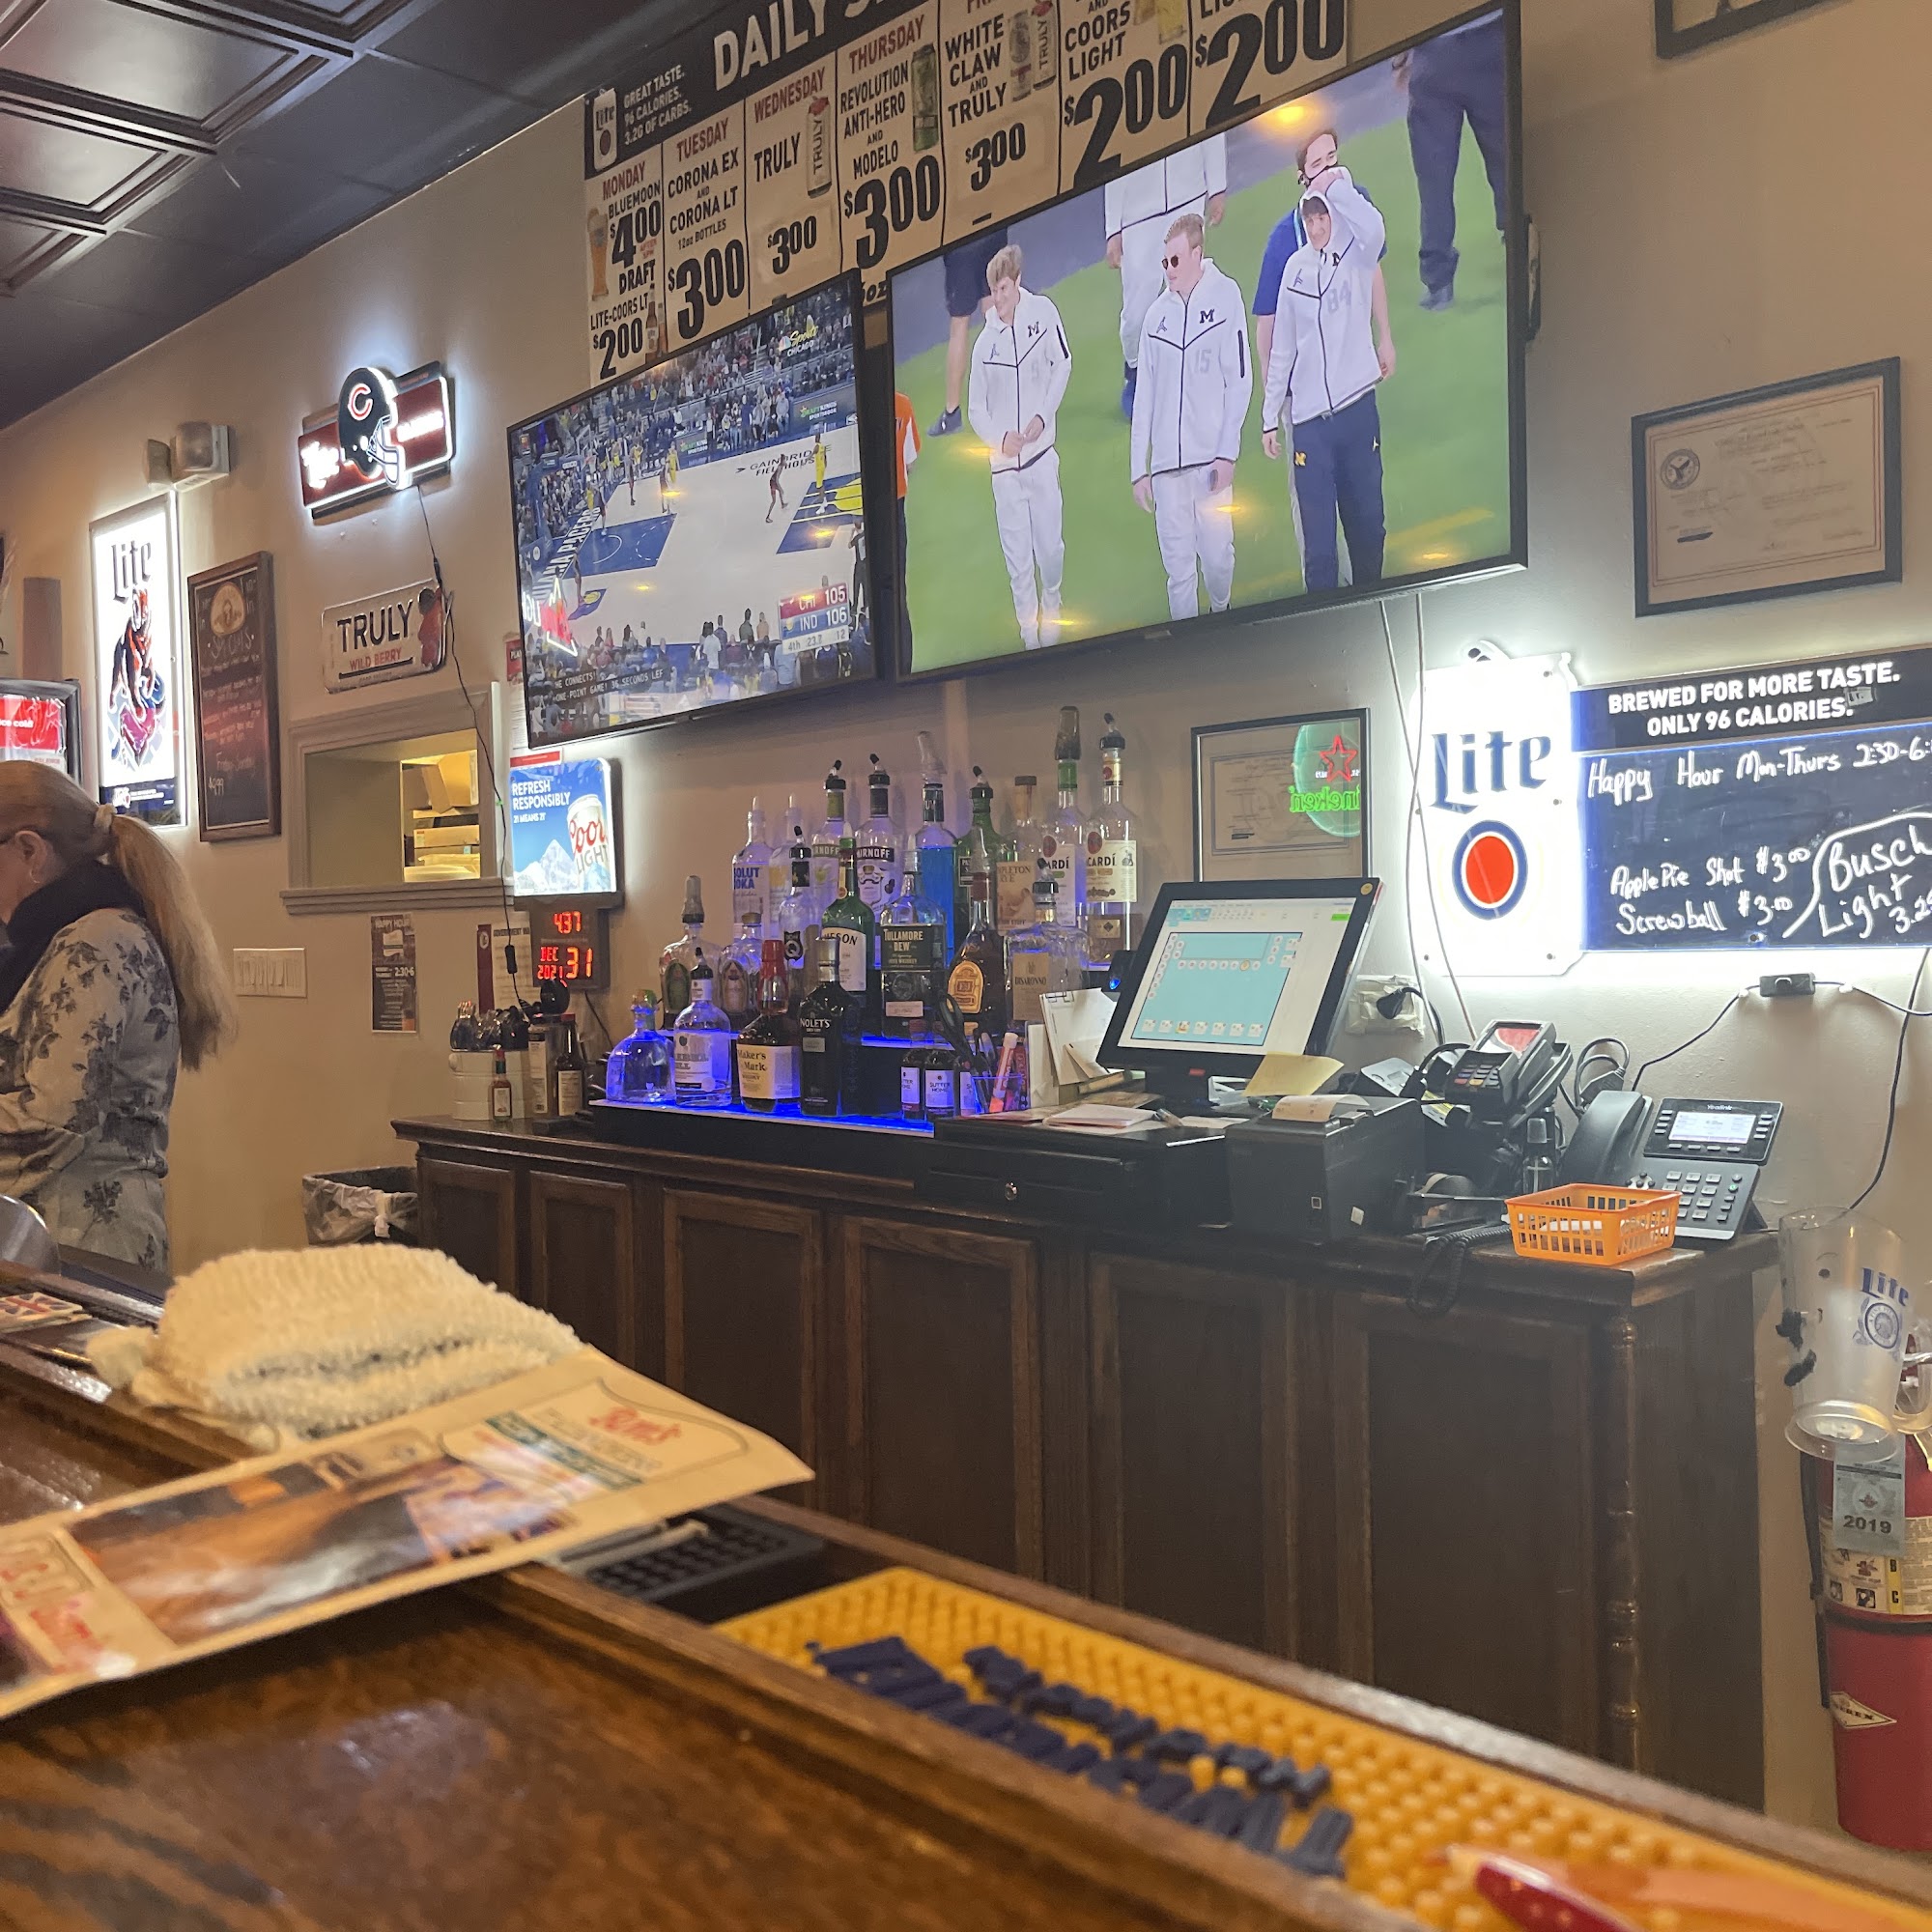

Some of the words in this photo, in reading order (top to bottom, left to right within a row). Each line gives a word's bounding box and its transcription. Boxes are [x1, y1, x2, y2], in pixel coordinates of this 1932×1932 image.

[714, 0, 826, 91] DAILY
[849, 14, 924, 74] THURSDAY
[945, 14, 1004, 63] WHITE
[1037, 19, 1049, 71] TRULY
[1065, 1, 1130, 52] COORS
[949, 43, 1001, 87] CLAW
[1068, 31, 1126, 81] LIGHT
[623, 80, 652, 108] GREAT
[654, 64, 685, 92] TASTE.
[753, 67, 825, 124] WEDNESDAY
[840, 60, 909, 115] REVOLUTION
[969, 76, 988, 94] AND
[595, 105, 614, 131] Lite
[624, 112, 635, 128] 96
[636, 86, 682, 121] CALORIES.
[625, 125, 643, 146] 3.2G
[645, 117, 657, 134] OF
[658, 99, 692, 128] CARBS.
[843, 91, 905, 140] ANTI-HERO
[948, 82, 1008, 128] TRULY
[676, 117, 728, 162] TUESDAY
[812, 120, 824, 175] TRULY
[867, 129, 883, 145] AND
[668, 158, 719, 199] CORONA
[722, 147, 739, 173] EX
[754, 132, 801, 183] TRULY
[853, 140, 898, 180] MODELO
[603, 161, 645, 201] MONDAY
[609, 180, 661, 219] BLUEMOON
[696, 185, 710, 200] AND
[669, 195, 721, 235] CORONA
[724, 185, 738, 211] LT
[695, 218, 726, 242] BOTTLES
[619, 259, 656, 296] DRAFT
[590, 296, 638, 330] LITE-COORS
[639, 292, 649, 311] LT
[1200, 309, 1215, 323] M
[787, 339, 813, 356] CHICAGO
[789, 324, 818, 345] Sports
[111, 540, 151, 604] Lite
[799, 594, 816, 611] CHI
[825, 585, 845, 605] 105
[337, 599, 413, 652] TRULY
[800, 614, 817, 631] IND
[826, 607, 846, 626] 106
[350, 655, 372, 671] WILD
[375, 647, 402, 666] BERRY
[788, 640, 800, 651] 4th
[837, 629, 845, 639] 12
[622, 673, 648, 687] SECONDS
[1608, 686, 1696, 714] BREWED
[1701, 680, 1744, 705] FOR
[1747, 670, 1813, 699] MORE
[1817, 661, 1901, 690] TASTE.
[1647, 711, 1701, 737] ONLY
[1705, 709, 1730, 731] 96
[1735, 696, 1854, 726] CALORIES.
[511, 780, 551, 796] REFRESH
[1430, 730, 1551, 814] Lite
[1588, 757, 1653, 806] Happy
[1677, 751, 1723, 788] Hour
[512, 792, 570, 810] RESPONSIBLY
[520, 813, 538, 823] MEANS
[576, 844, 609, 874] LIGHT
[1087, 853, 1116, 867] CARDÍ
[1706, 856, 1745, 886] Shot
[1829, 825, 1932, 892] Busch
[1616, 899, 1727, 935] Screwball
[1818, 872, 1913, 939] Light
[883, 928, 923, 941] TULLAMORE
[894, 942, 910, 952] DEW
[540, 947, 558, 962] DEC
[566, 947, 593, 980] 31
[1015, 977, 1046, 985] DISARONNO
[800, 1018, 831, 1028] NOLET'S
[738, 1050, 766, 1060] Maker's
[745, 1062, 767, 1071] Mark
[1861, 1267, 1909, 1307] Lite
[1843, 1515, 1891, 1534] 2019
